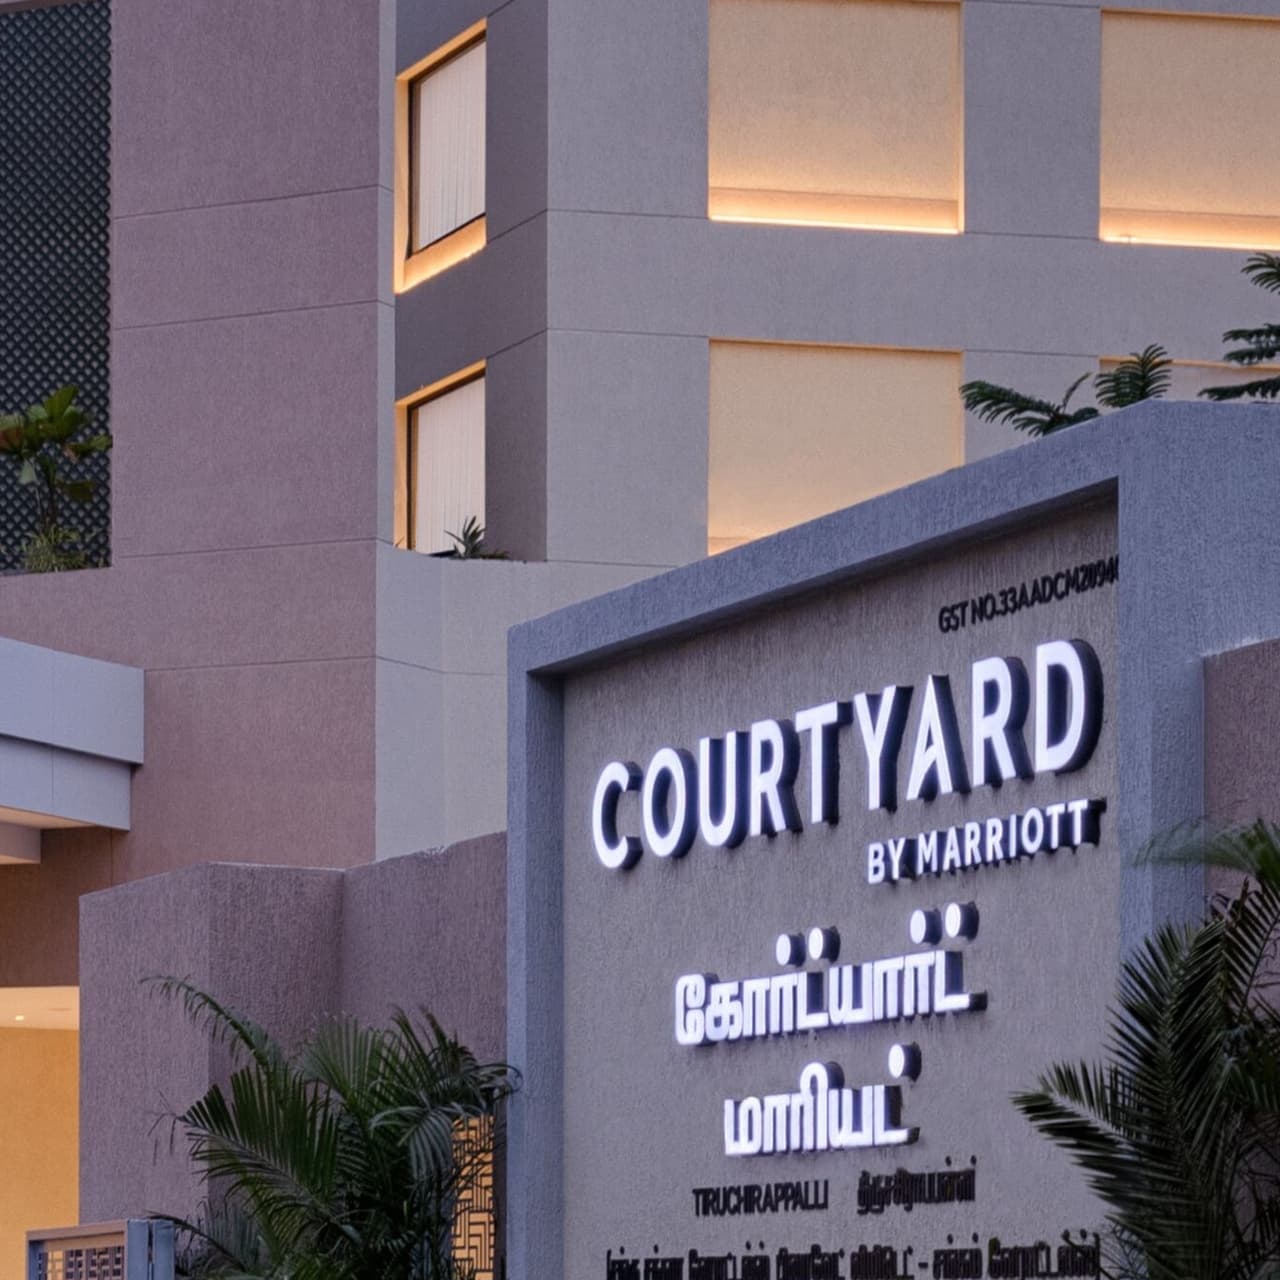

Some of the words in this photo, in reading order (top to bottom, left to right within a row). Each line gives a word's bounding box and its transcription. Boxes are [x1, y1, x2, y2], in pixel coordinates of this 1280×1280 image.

[938, 600, 969, 634] GST
[592, 639, 1095, 870] COURTYARD
[867, 837, 908, 885] BY
[916, 799, 1097, 876] MARRIOTT
[723, 1043, 912, 1156] மாரியட்
[691, 1178, 829, 1217] TIRUCHIRAPPALLI
